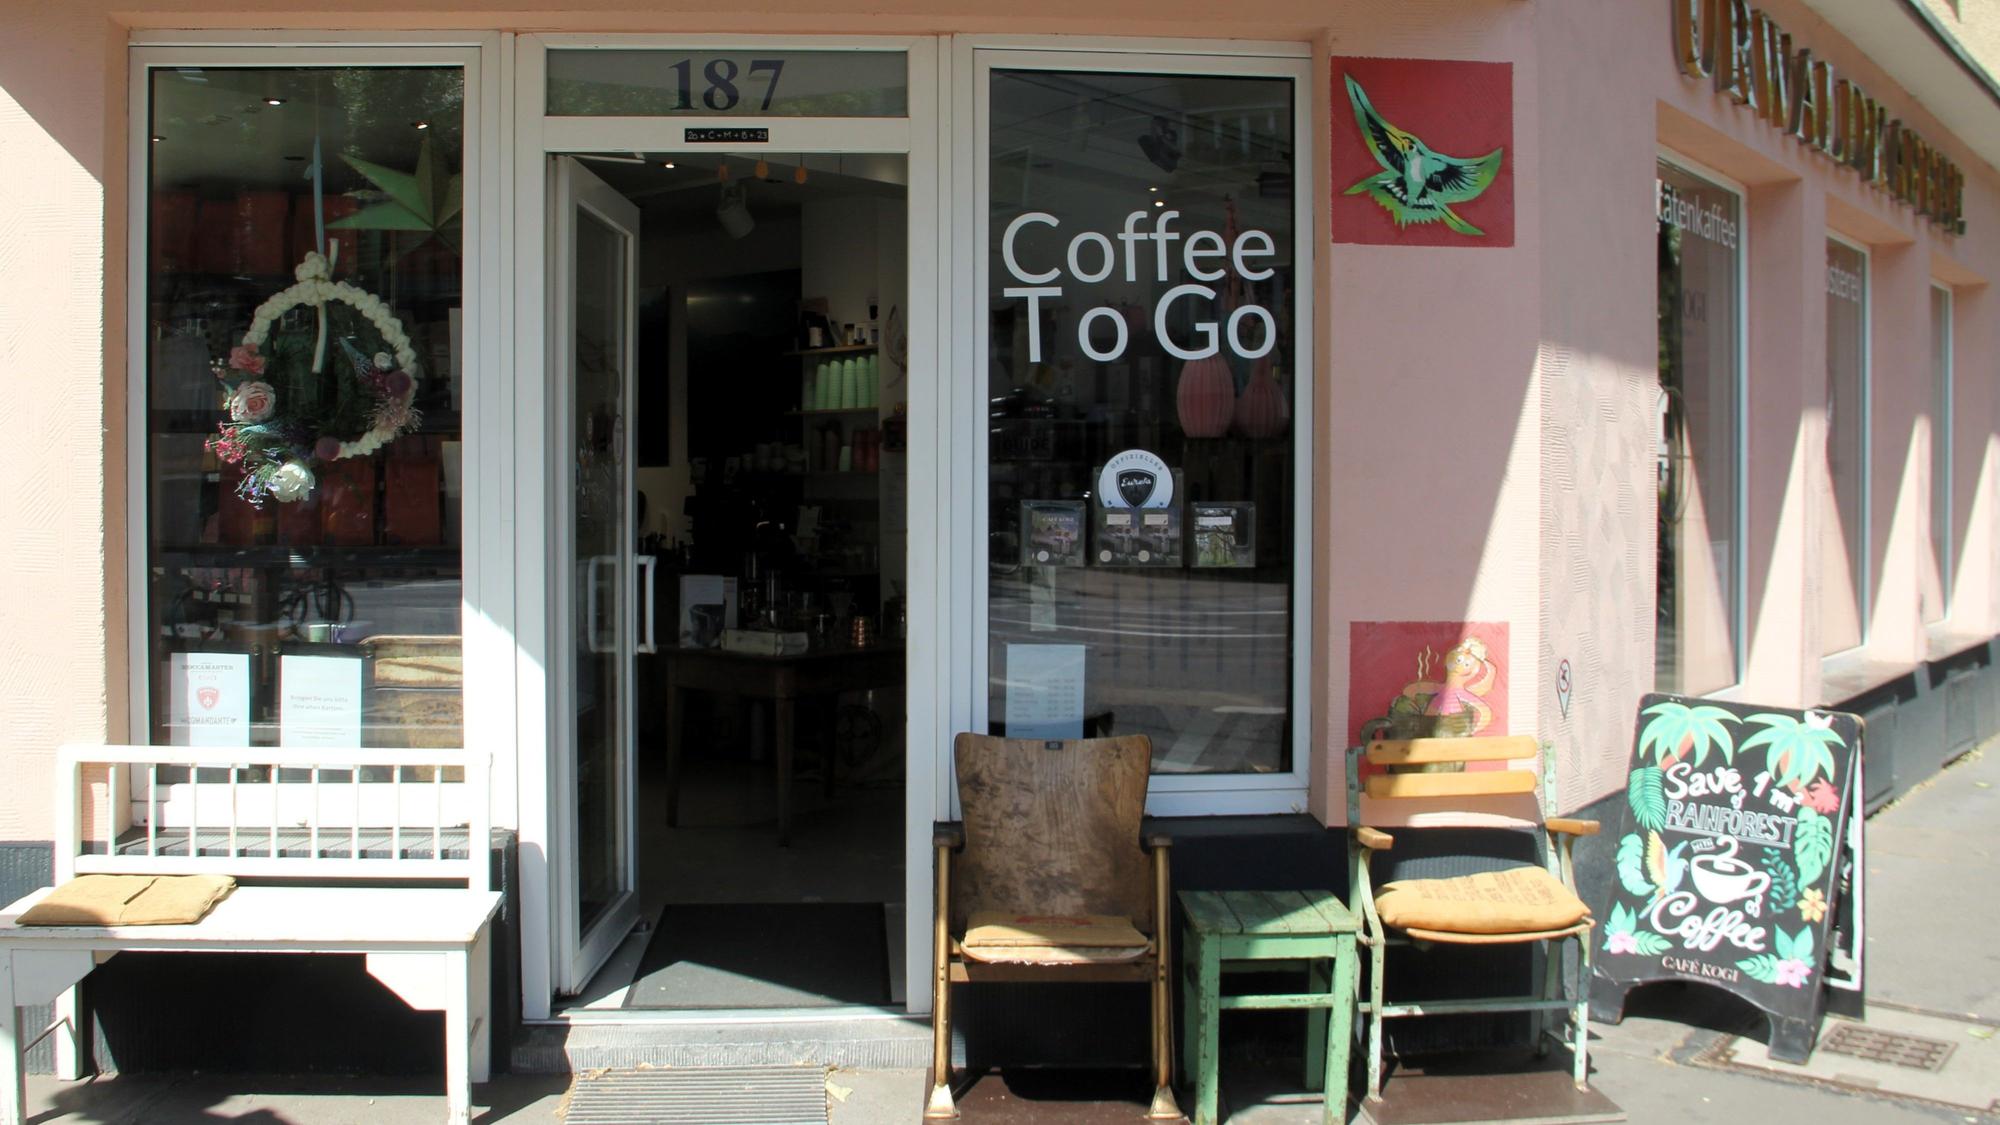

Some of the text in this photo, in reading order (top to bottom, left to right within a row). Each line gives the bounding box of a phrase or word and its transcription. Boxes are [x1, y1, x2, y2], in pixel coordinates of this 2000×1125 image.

[669, 59, 785, 112] 187
[1002, 210, 1276, 284] Coffee
[1003, 284, 1277, 363] To Go
[1664, 762, 1742, 800] Save
[1752, 770, 1771, 798] 1
[1666, 799, 1797, 844] RAINFOREST
[1650, 890, 1766, 952] Coffee
[1700, 962, 1739, 982] KOGI
